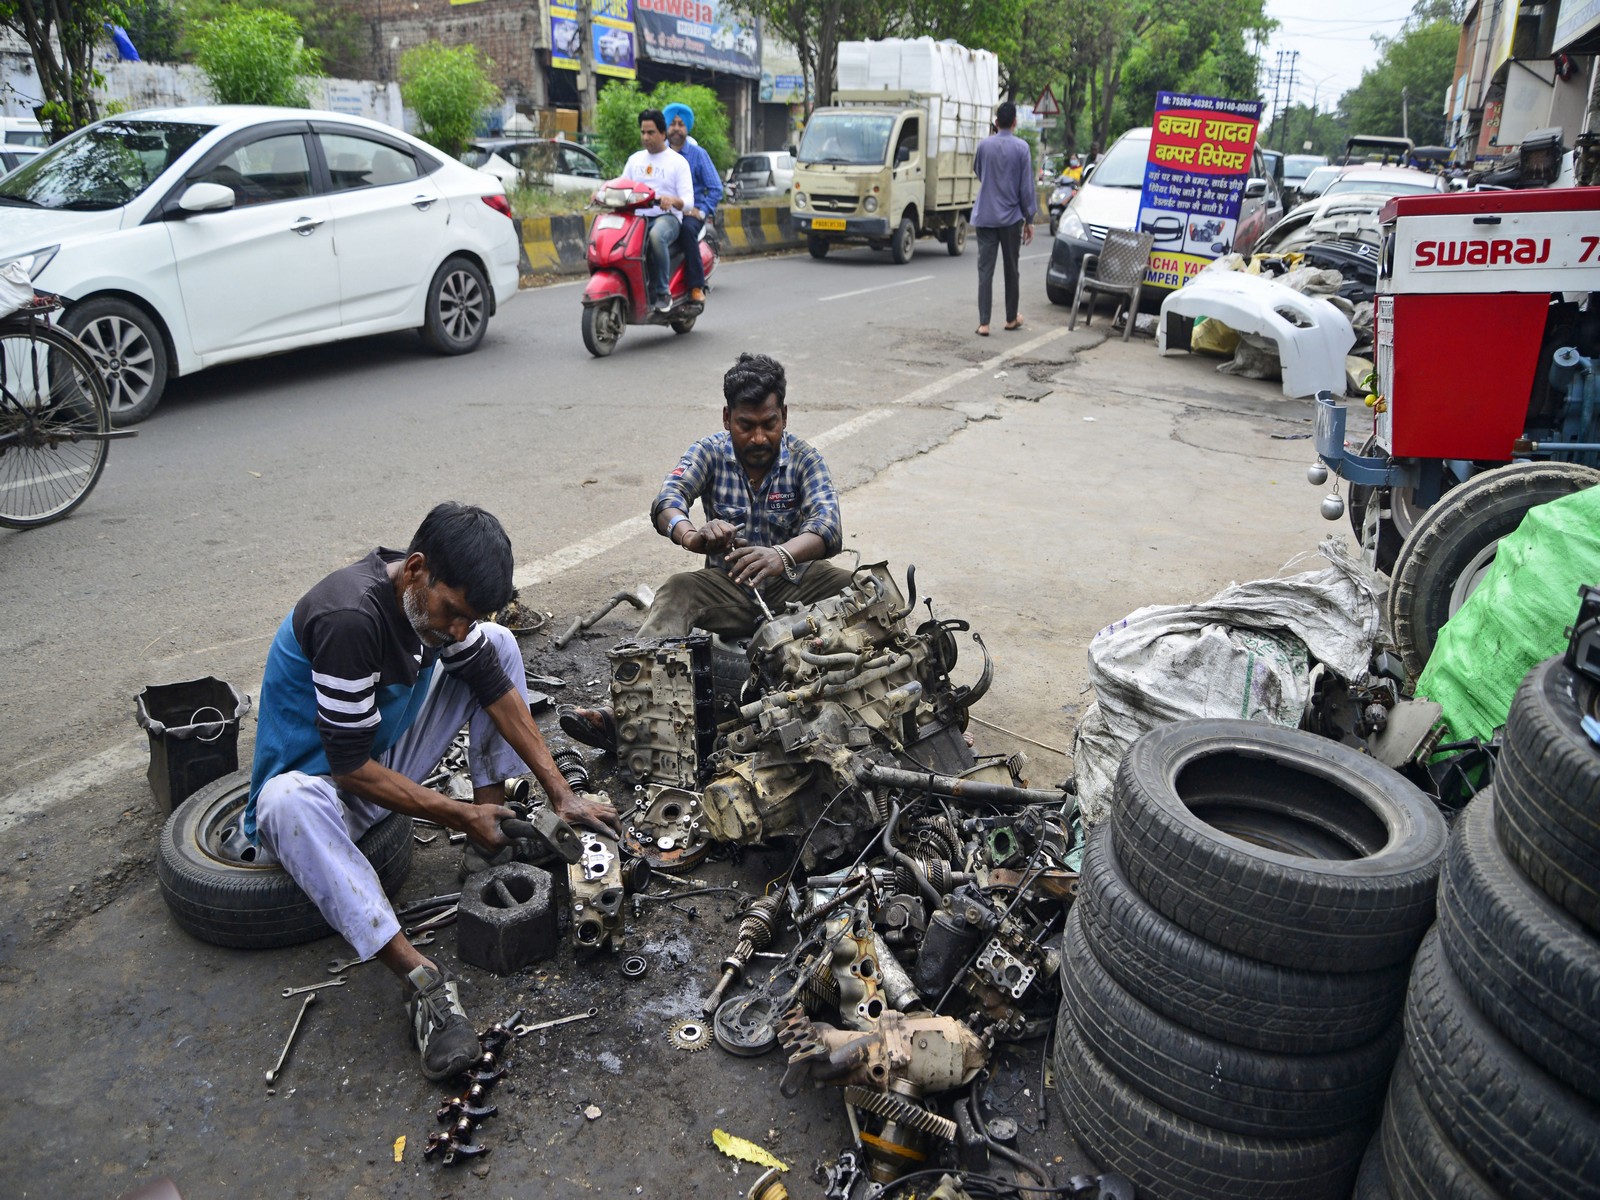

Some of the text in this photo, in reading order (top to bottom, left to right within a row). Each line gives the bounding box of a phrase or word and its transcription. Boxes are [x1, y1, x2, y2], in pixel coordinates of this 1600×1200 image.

[1204, 119, 1255, 144] यादव
[1155, 142, 1247, 170] बम्पर रिपेयर
[1577, 236, 1600, 263] 7
